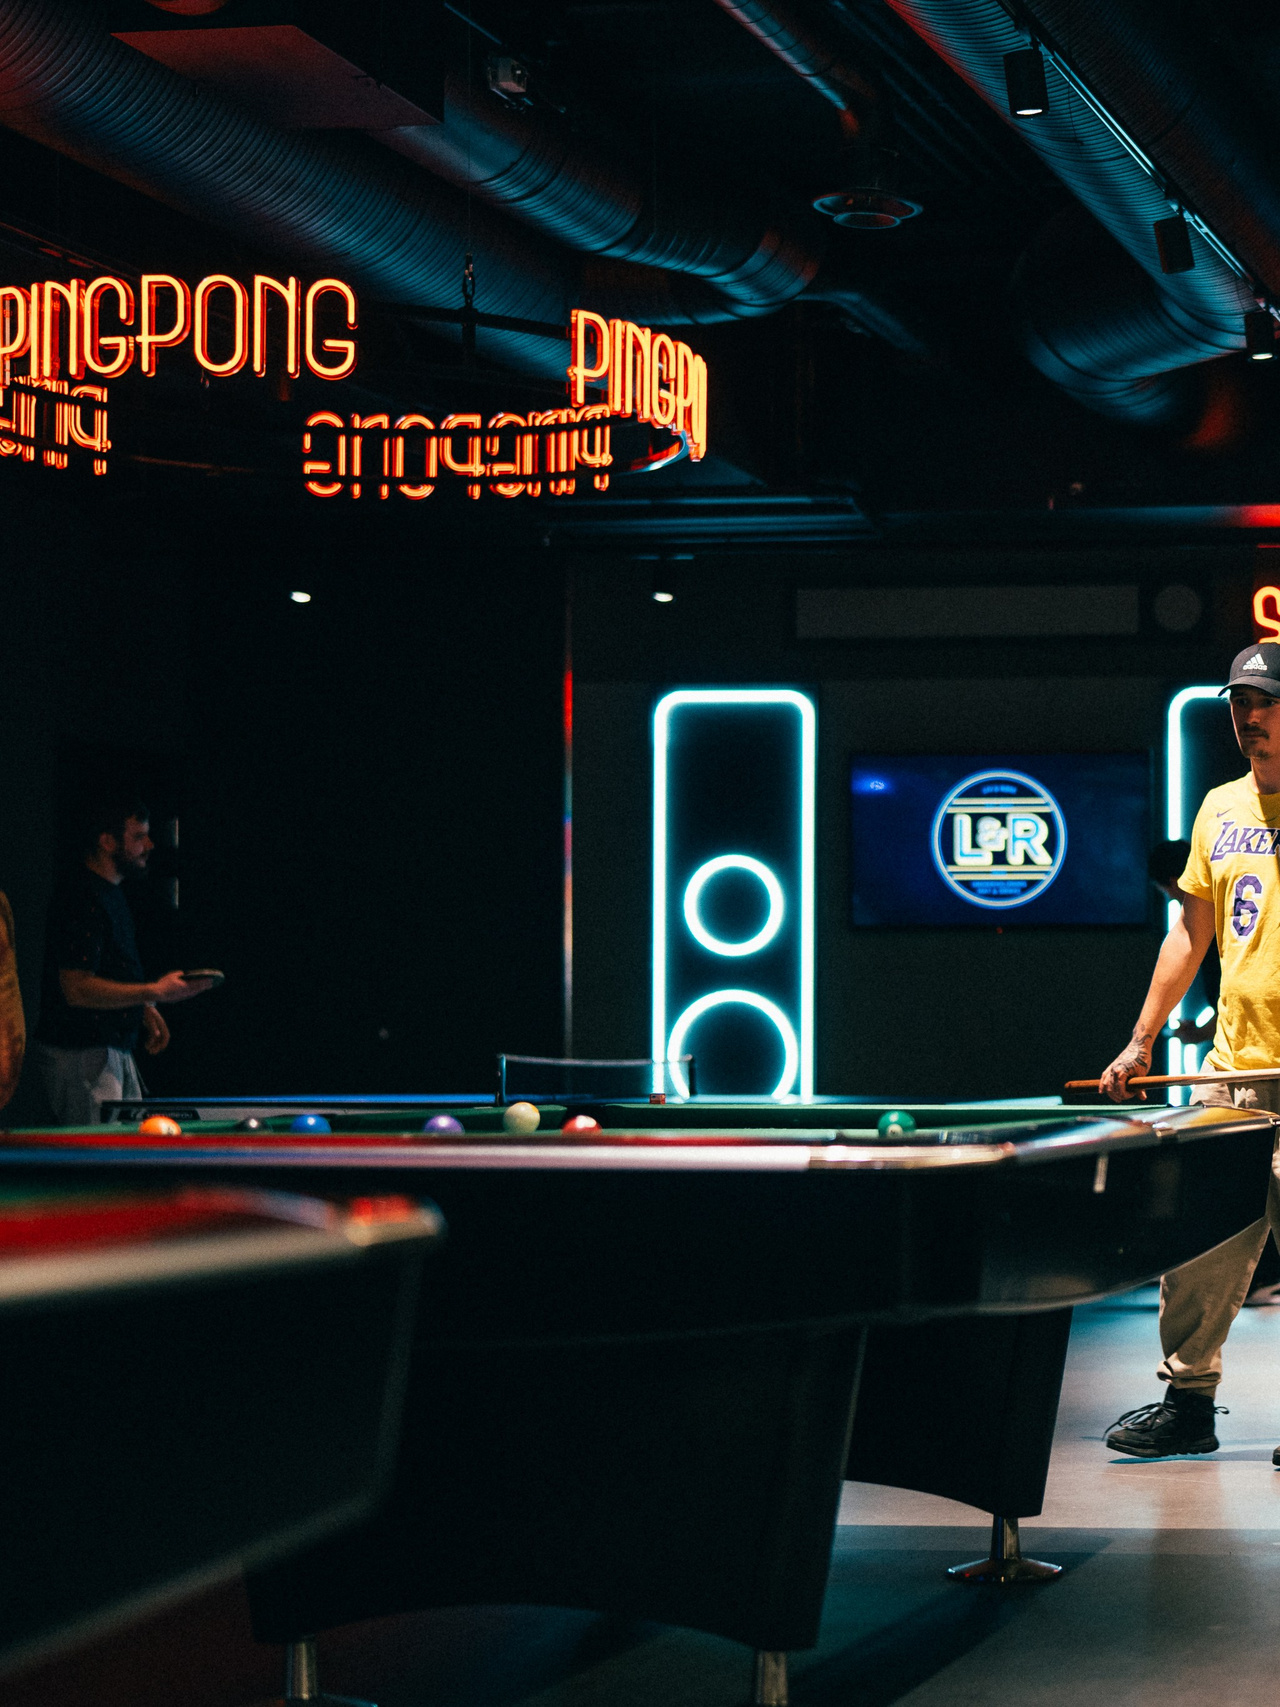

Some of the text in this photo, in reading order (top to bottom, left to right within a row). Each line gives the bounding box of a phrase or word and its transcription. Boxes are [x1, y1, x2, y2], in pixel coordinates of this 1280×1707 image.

[0, 274, 358, 380] PINGPONG
[953, 813, 1053, 866] L&R
[1232, 874, 1264, 940] 6
